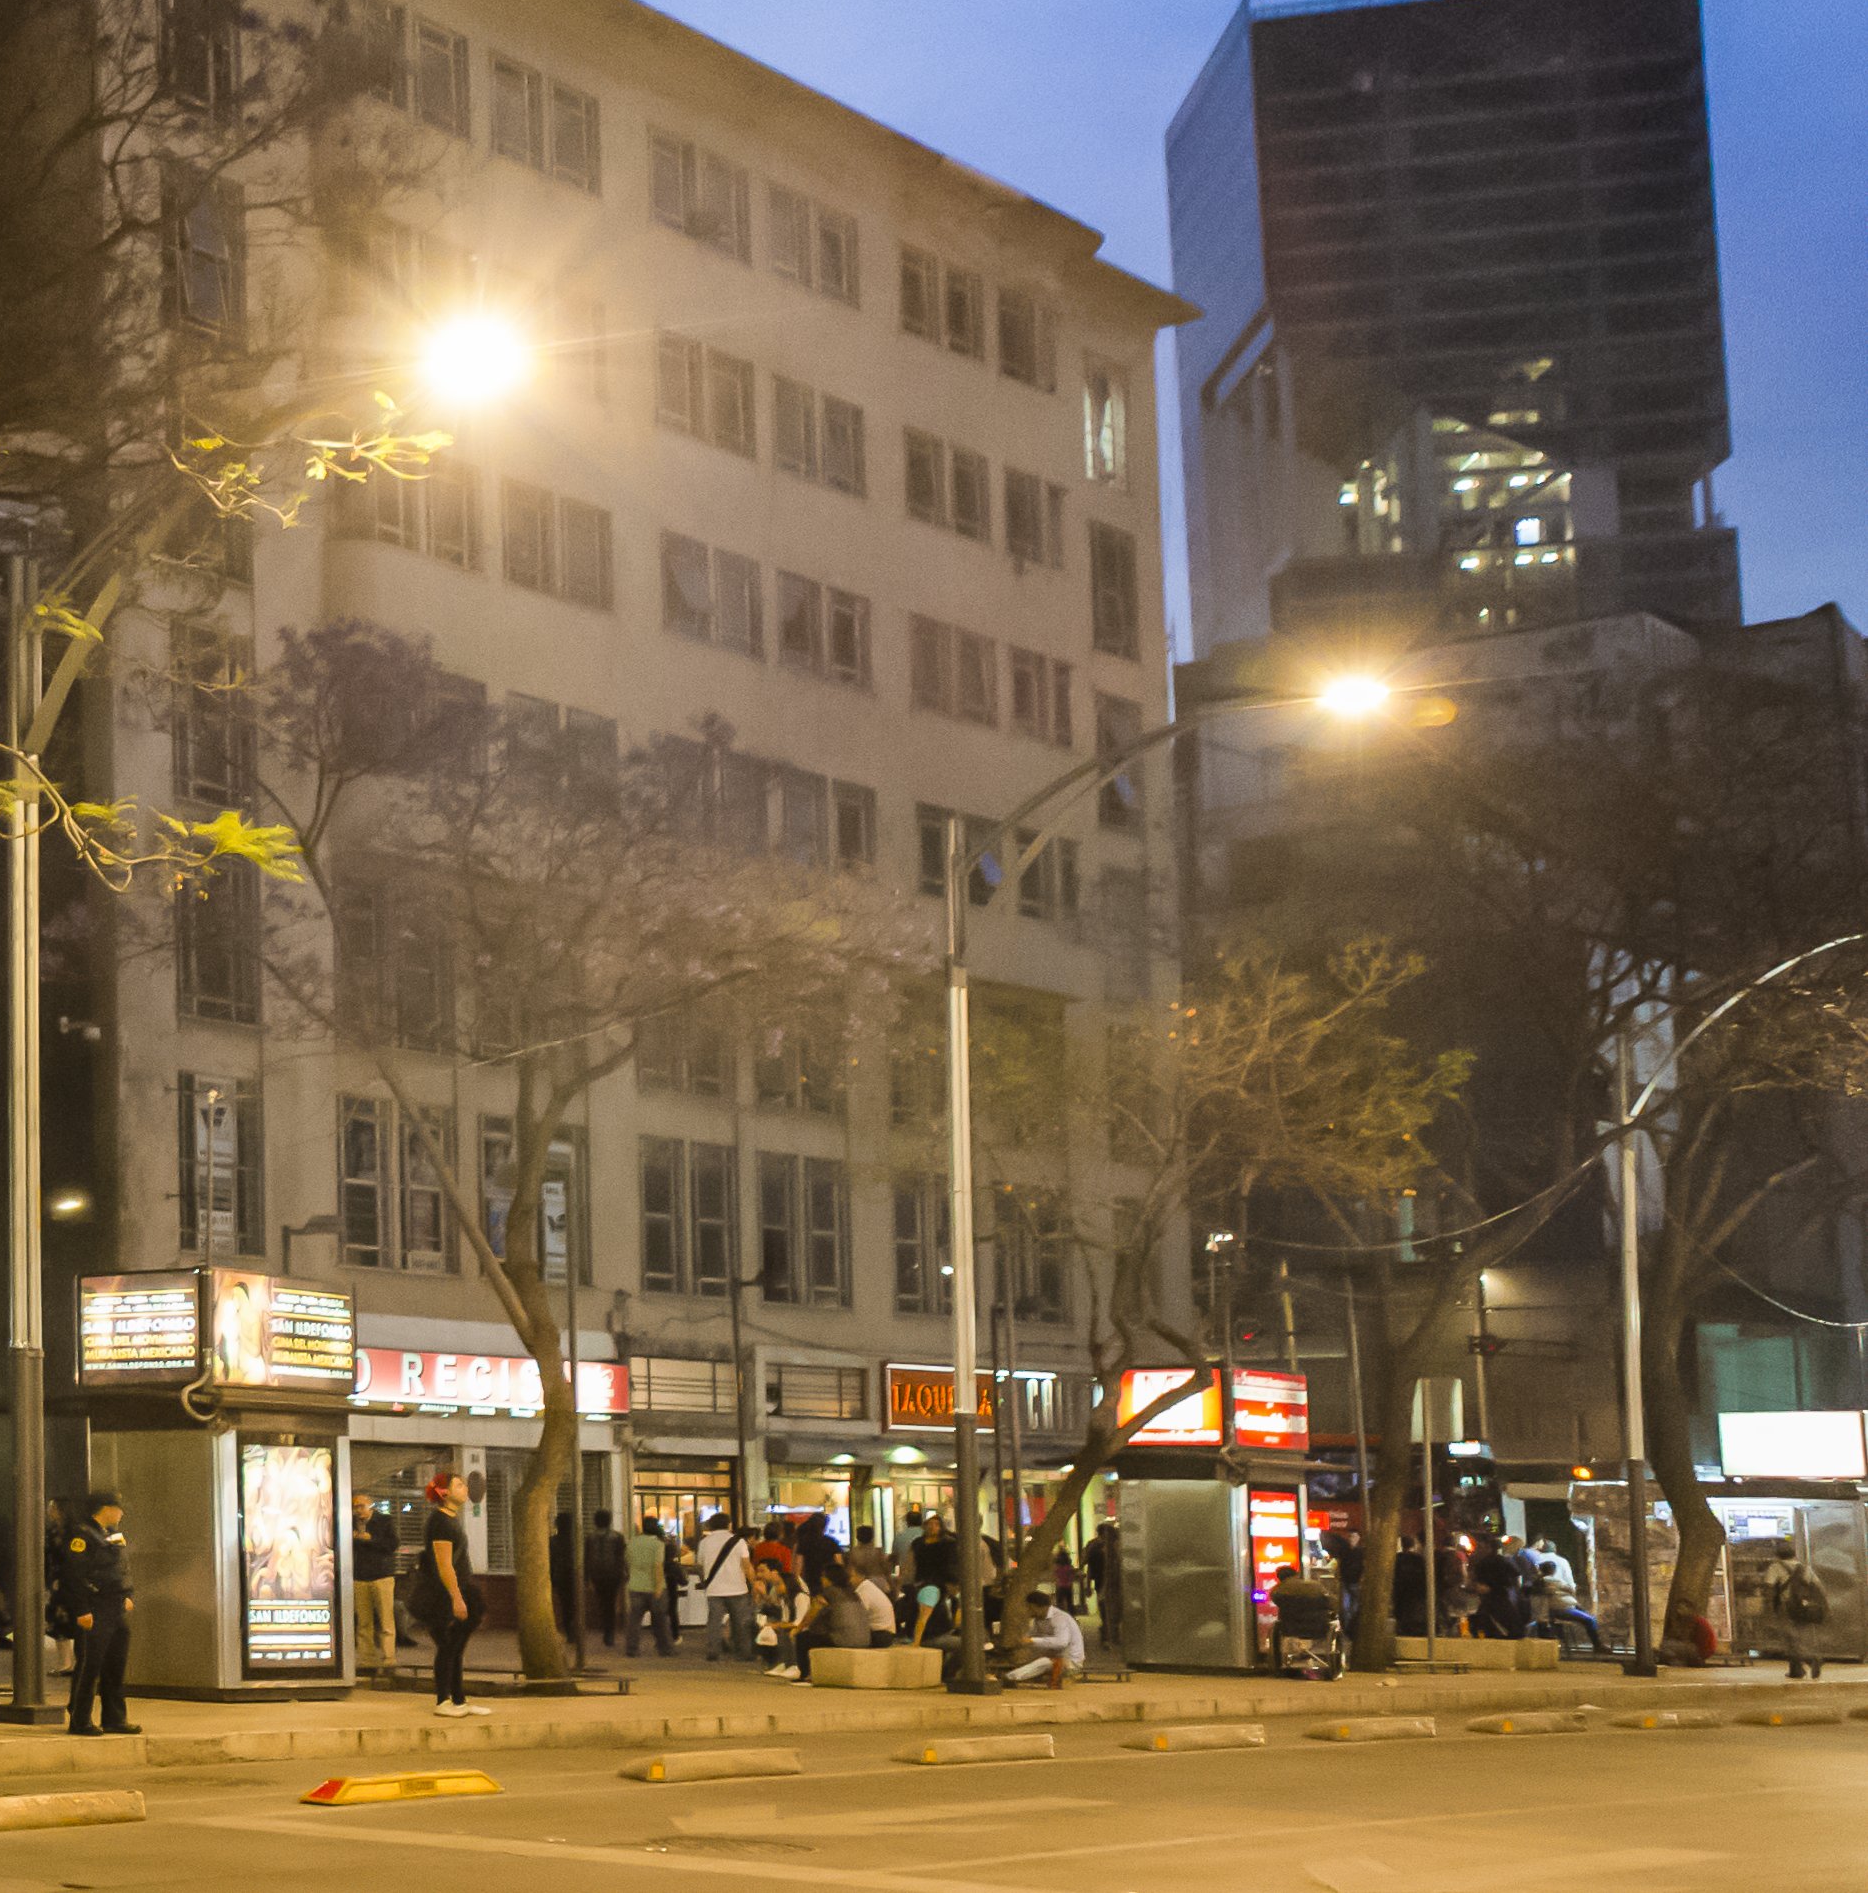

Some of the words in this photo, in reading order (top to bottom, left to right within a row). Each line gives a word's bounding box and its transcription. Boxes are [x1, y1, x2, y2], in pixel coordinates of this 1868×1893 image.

[401, 1352, 541, 1404] REGIS
[892, 1382, 993, 1418] TAQUA
[248, 1609, 272, 1624] SAN
[272, 1609, 331, 1624] ILDEFONSO
